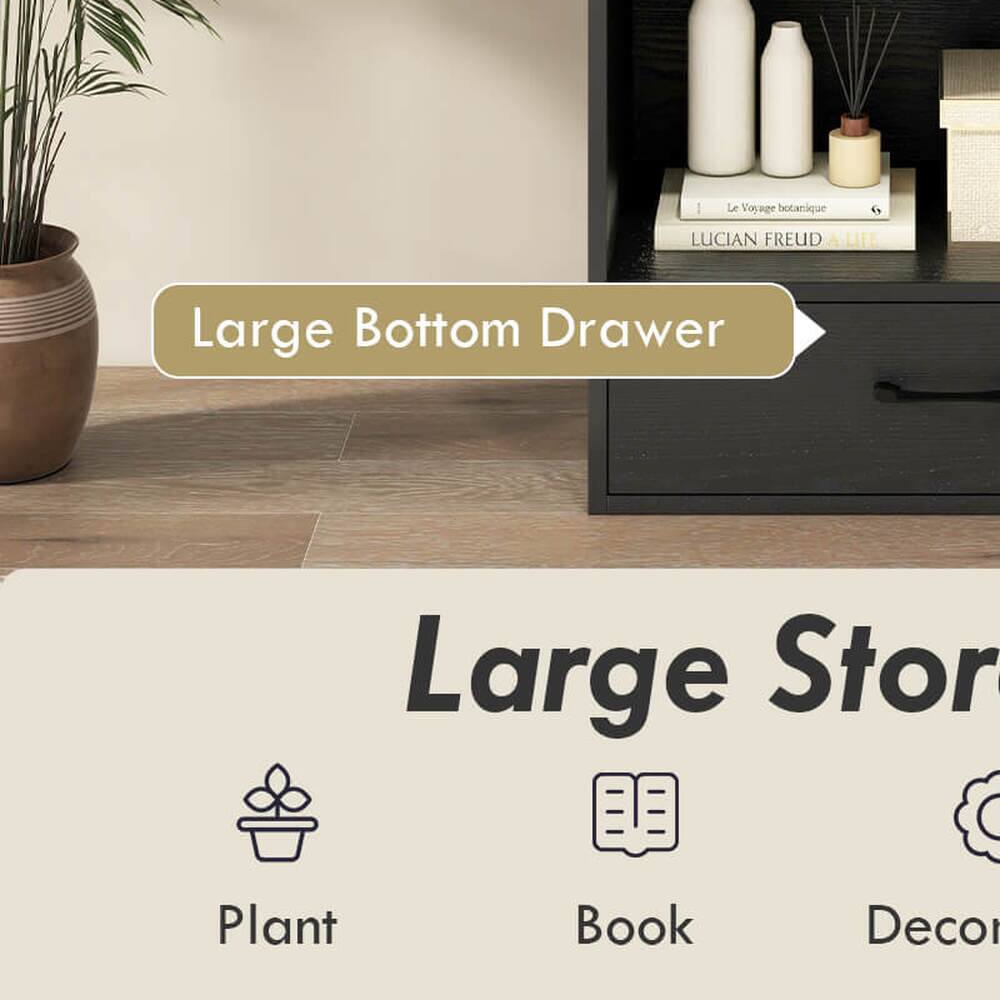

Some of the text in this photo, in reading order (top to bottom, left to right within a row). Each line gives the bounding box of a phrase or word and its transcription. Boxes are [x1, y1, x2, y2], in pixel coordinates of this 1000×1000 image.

[727, 202, 827, 215] Le Voyage botanique
[691, 231, 757, 247] LUCIAN
[764, 231, 822, 247] FREUD
